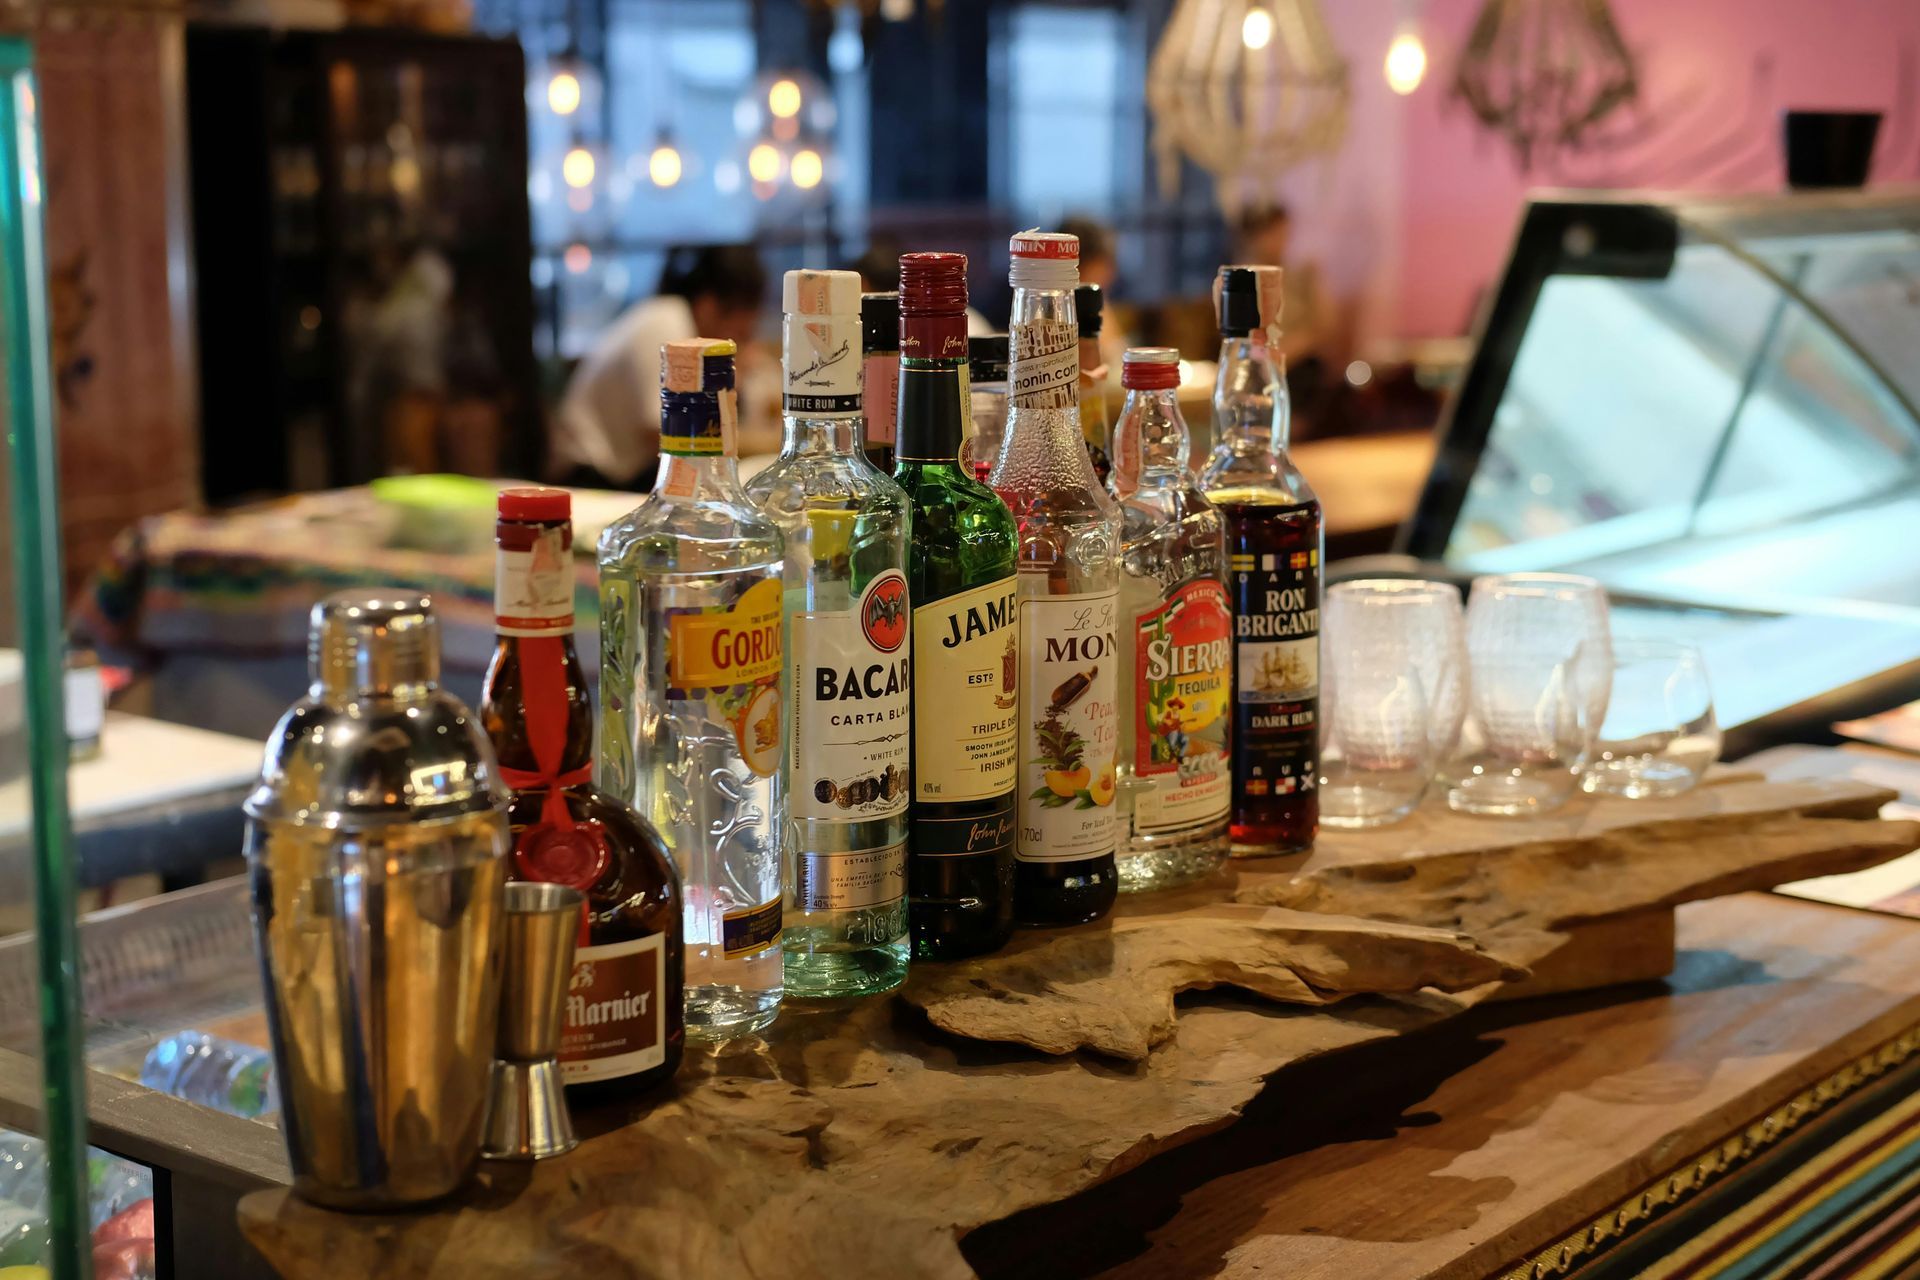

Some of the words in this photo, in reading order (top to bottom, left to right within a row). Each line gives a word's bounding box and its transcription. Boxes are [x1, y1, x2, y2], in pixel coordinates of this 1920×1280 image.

[815, 398, 836, 409] RUM
[1265, 587, 1306, 612] RON
[1064, 607, 1092, 631] Le
[1145, 633, 1230, 681] SIERRA
[816, 658, 908, 701] BACAR
[1178, 678, 1221, 695] TEQUILA
[831, 712, 884, 726] CARTA
[972, 719, 1006, 734] TRIPLE
[1252, 714, 1290, 729] DARK
[1291, 710, 1313, 726] RUM
[870, 748, 893, 761] WHITE
[965, 742, 993, 752] SMOOTH
[970, 753, 988, 761] JOHN
[980, 758, 1005, 773] IRISH
[1081, 820, 1094, 831] For
[1024, 827, 1043, 842] 70cl
[844, 851, 893, 866] ESTABLECIDO
